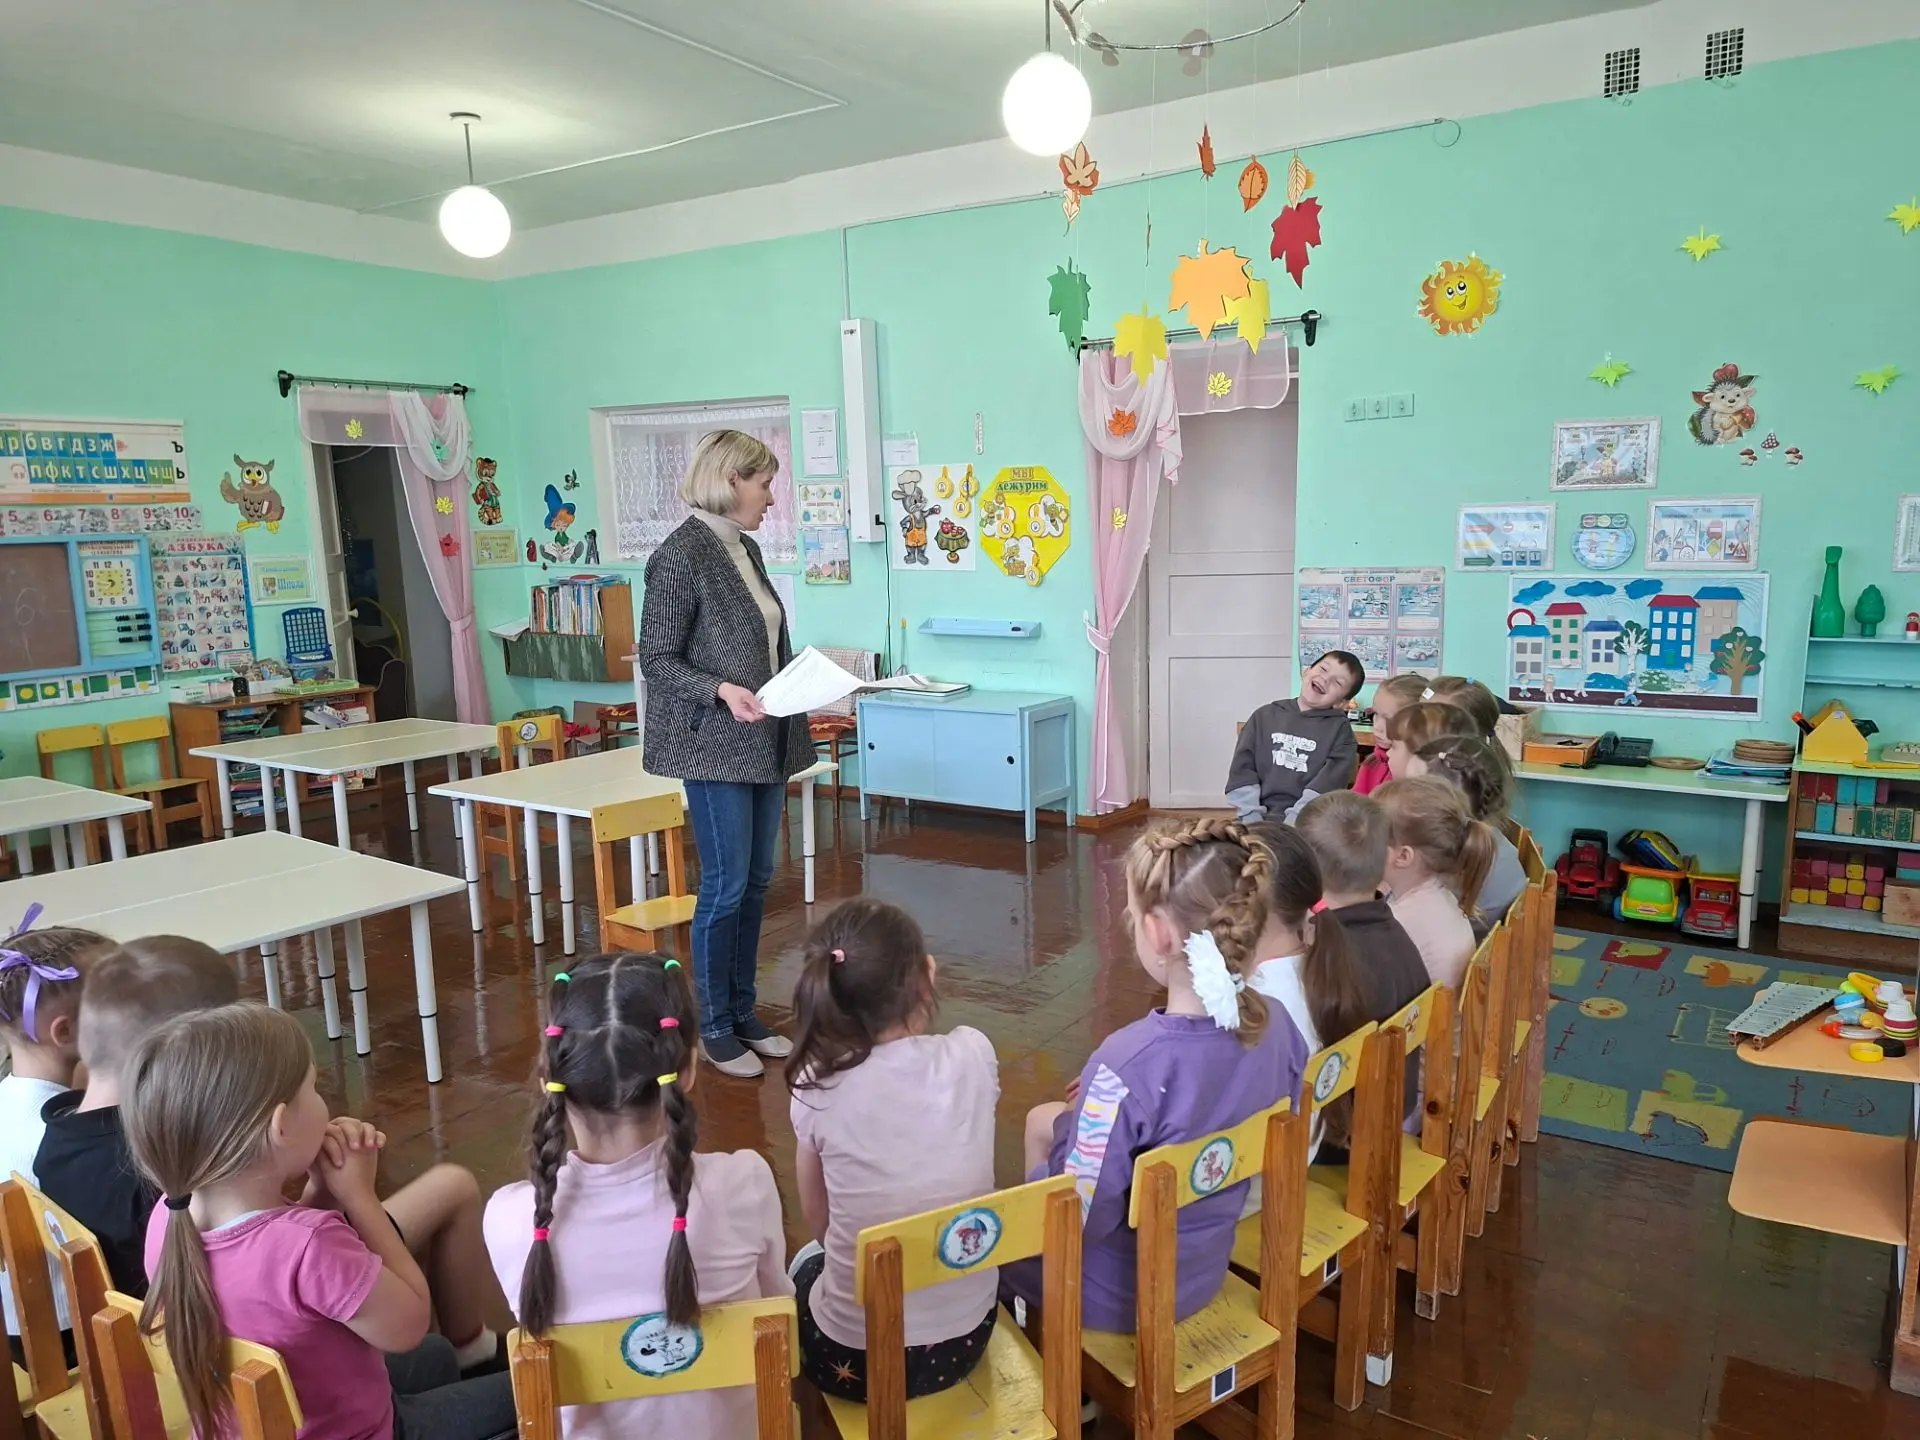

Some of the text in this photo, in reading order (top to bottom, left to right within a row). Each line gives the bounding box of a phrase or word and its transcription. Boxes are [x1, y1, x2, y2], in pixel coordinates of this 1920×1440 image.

[8, 437, 19, 455] р
[25, 432, 37, 450] б
[41, 437, 52, 450] в
[57, 437, 65, 450] г
[72, 438, 84, 455] д
[87, 438, 96, 452] з
[100, 439, 114, 452] ж
[30, 465, 41, 478] п
[45, 461, 58, 483] ф
[61, 465, 72, 478] к
[75, 465, 85, 478] т
[91, 465, 101, 479] с
[104, 465, 118, 479] ш
[121, 465, 131, 478] х
[134, 466, 146, 482] ц
[149, 466, 159, 479] ч
[161, 466, 174, 482] щ
[8, 507, 189, 523] 5 6 7 8 9 10
[168, 543, 225, 552] АЗБУКА
[93, 561, 99, 569] 11
[104, 560, 112, 568] 12
[85, 569, 131, 578] 10 2
[88, 578, 133, 588] 9 3
[90, 589, 95, 598] 8
[98, 596, 127, 606] 7 6 5
